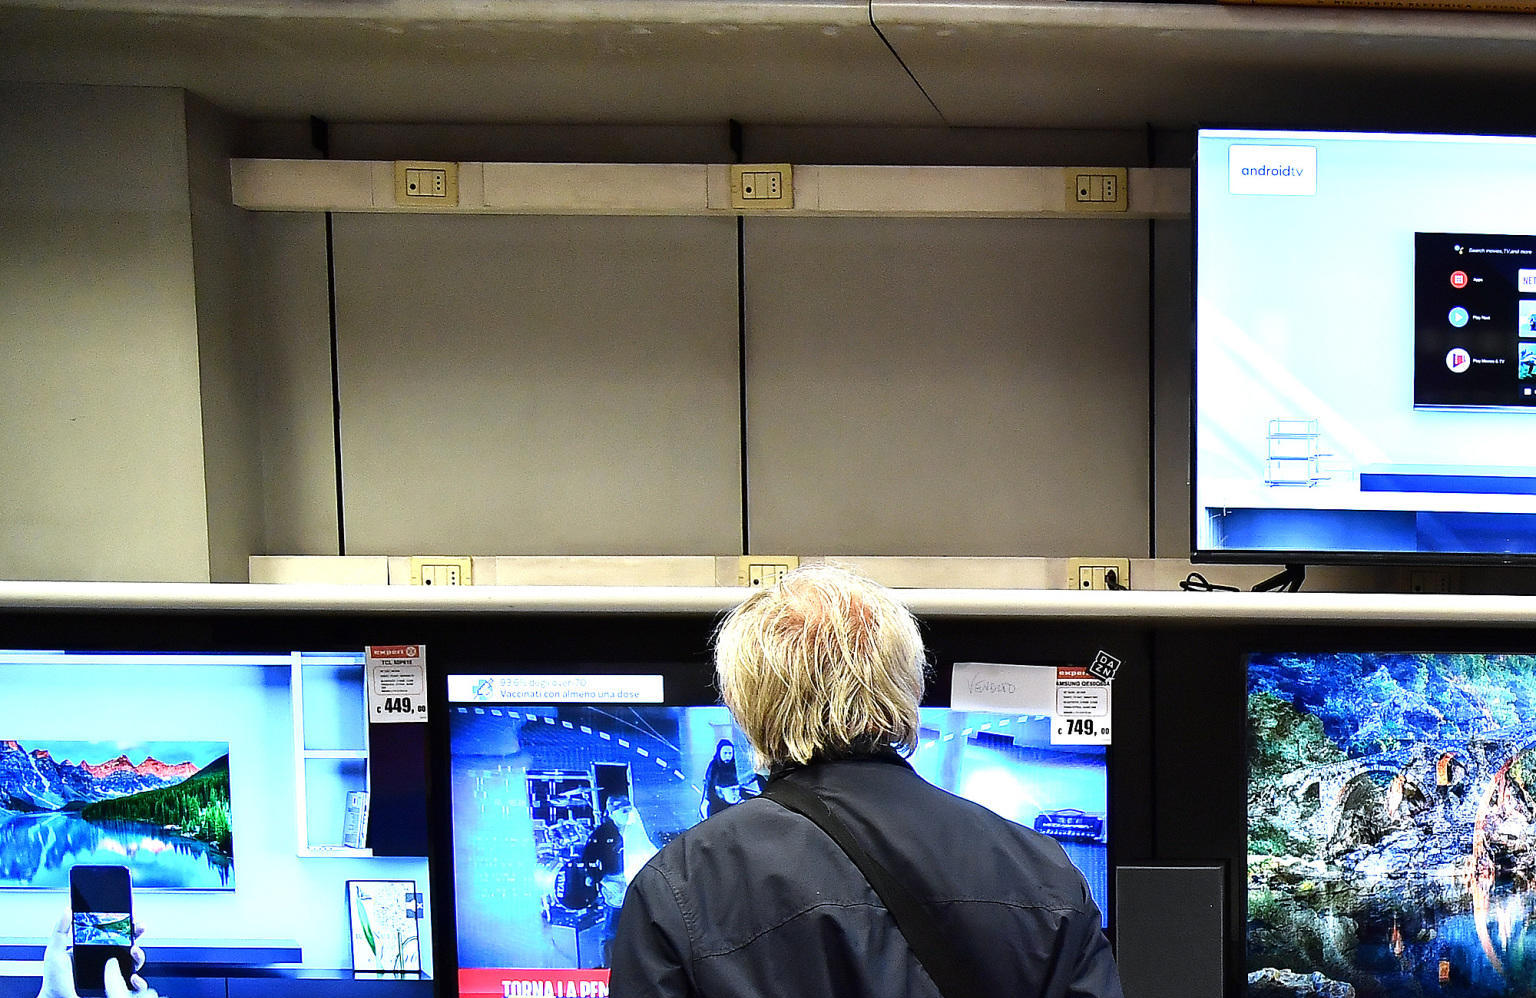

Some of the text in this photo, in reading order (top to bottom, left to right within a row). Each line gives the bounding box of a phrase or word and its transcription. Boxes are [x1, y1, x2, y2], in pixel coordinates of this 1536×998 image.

[1241, 164, 1304, 177] androidtv
[500, 689, 543, 698] Vaccinati
[562, 690, 596, 698] almeno
[620, 690, 640, 698] dose
[1101, 727, 1110, 735] 00
[501, 980, 556, 997] TORNA
